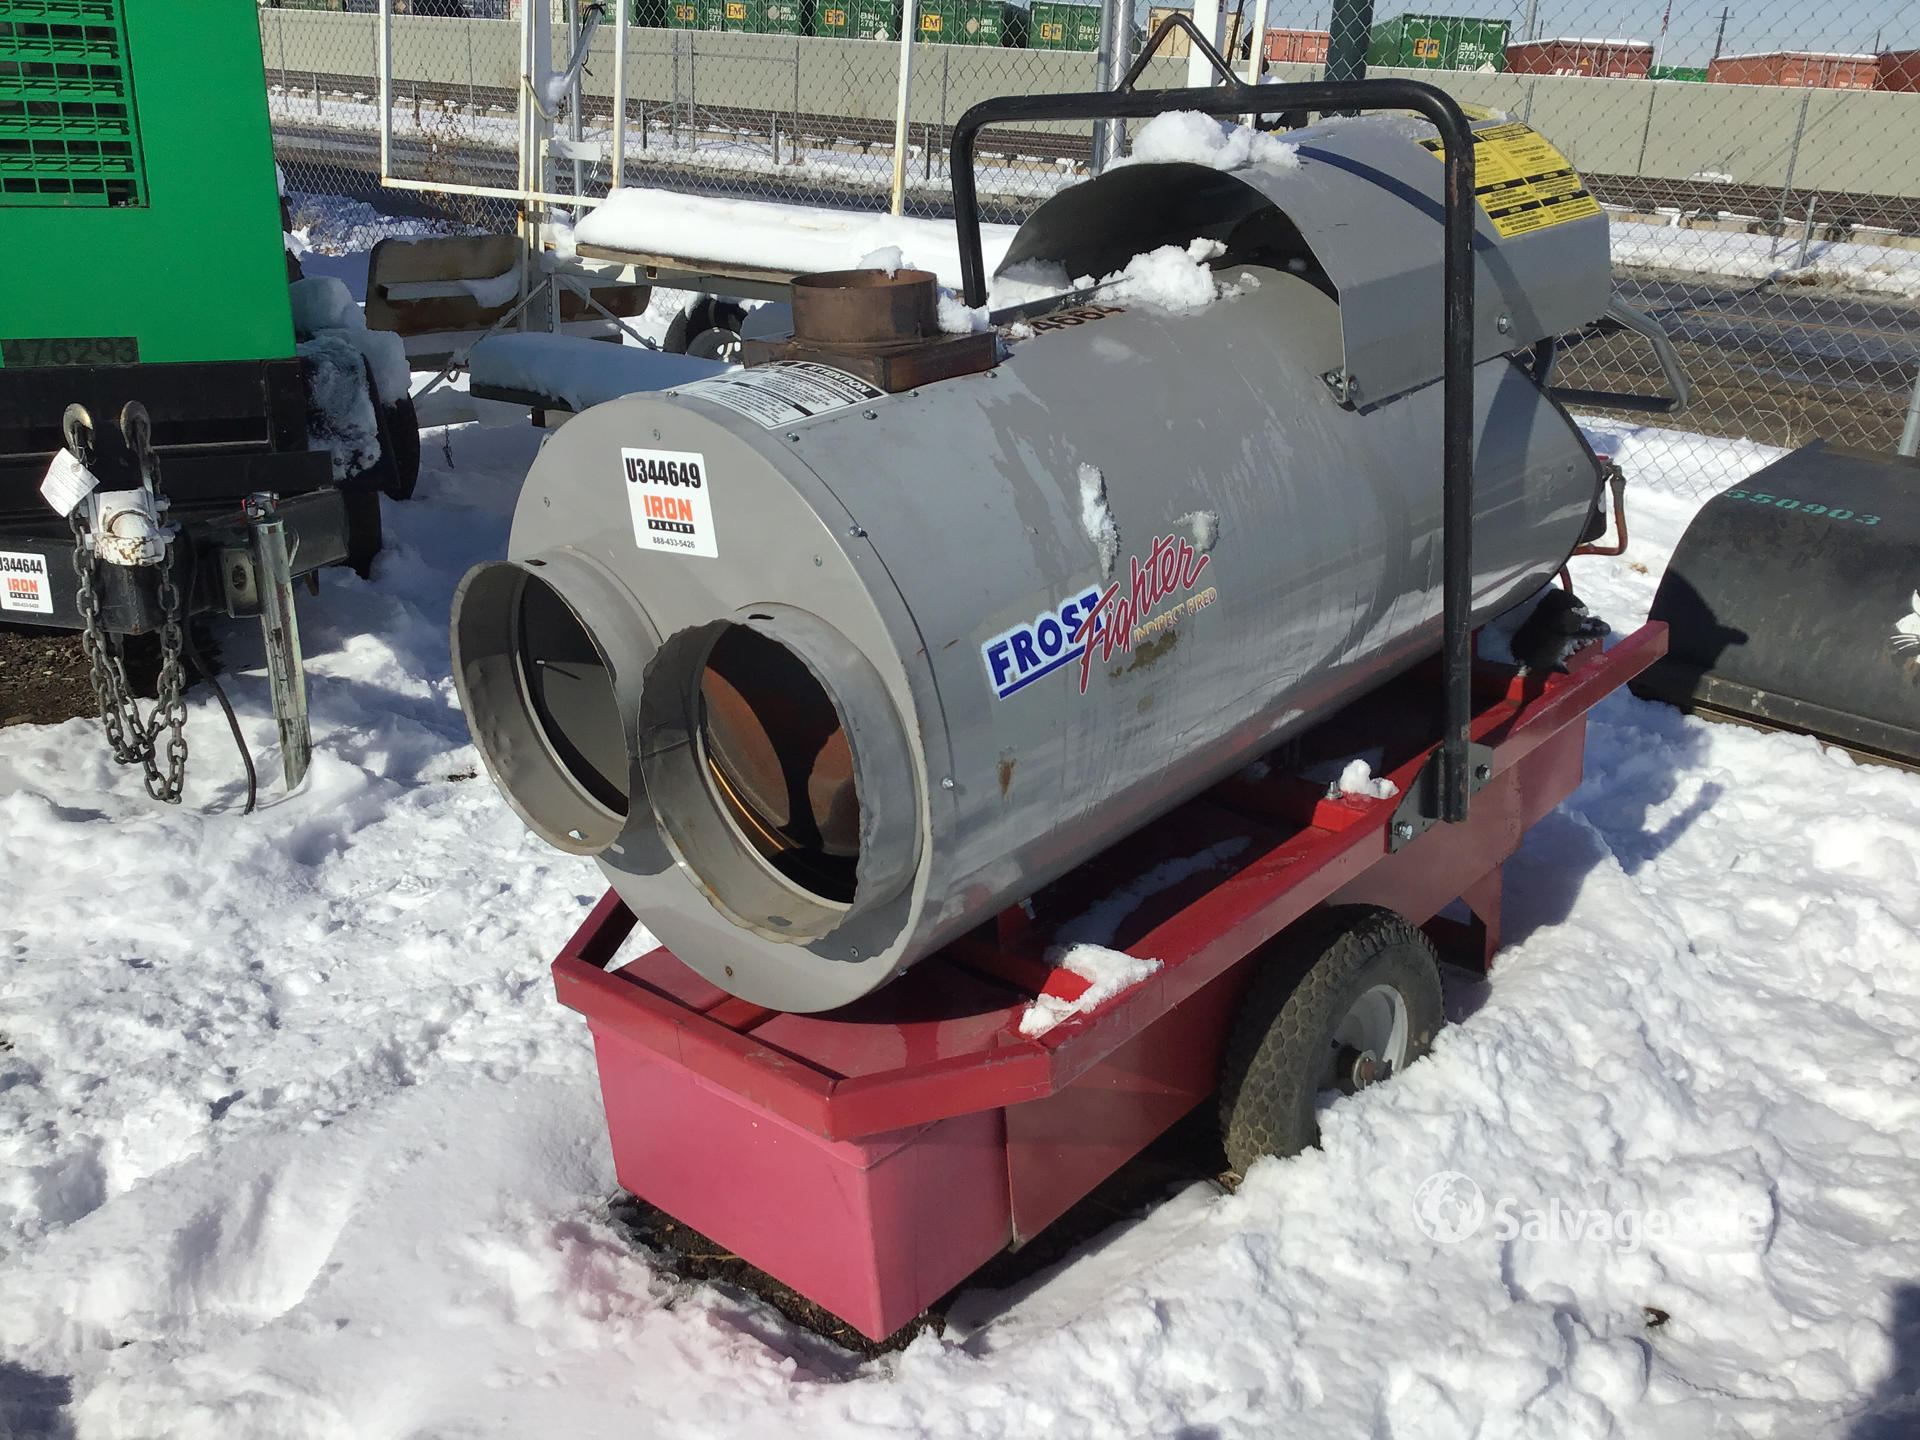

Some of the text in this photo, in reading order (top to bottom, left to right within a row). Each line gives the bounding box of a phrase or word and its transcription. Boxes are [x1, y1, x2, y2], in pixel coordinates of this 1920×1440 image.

[804, 364, 872, 394] ATTENTION
[625, 457, 701, 488] U344649
[643, 494, 693, 522] IRON
[1723, 489, 1881, 525] 550903
[651, 521, 692, 533] PLANET
[652, 536, 695, 549] 888-433-5426
[7, 577, 38, 593] IRON
[986, 534, 1211, 695] FROST Fighter
